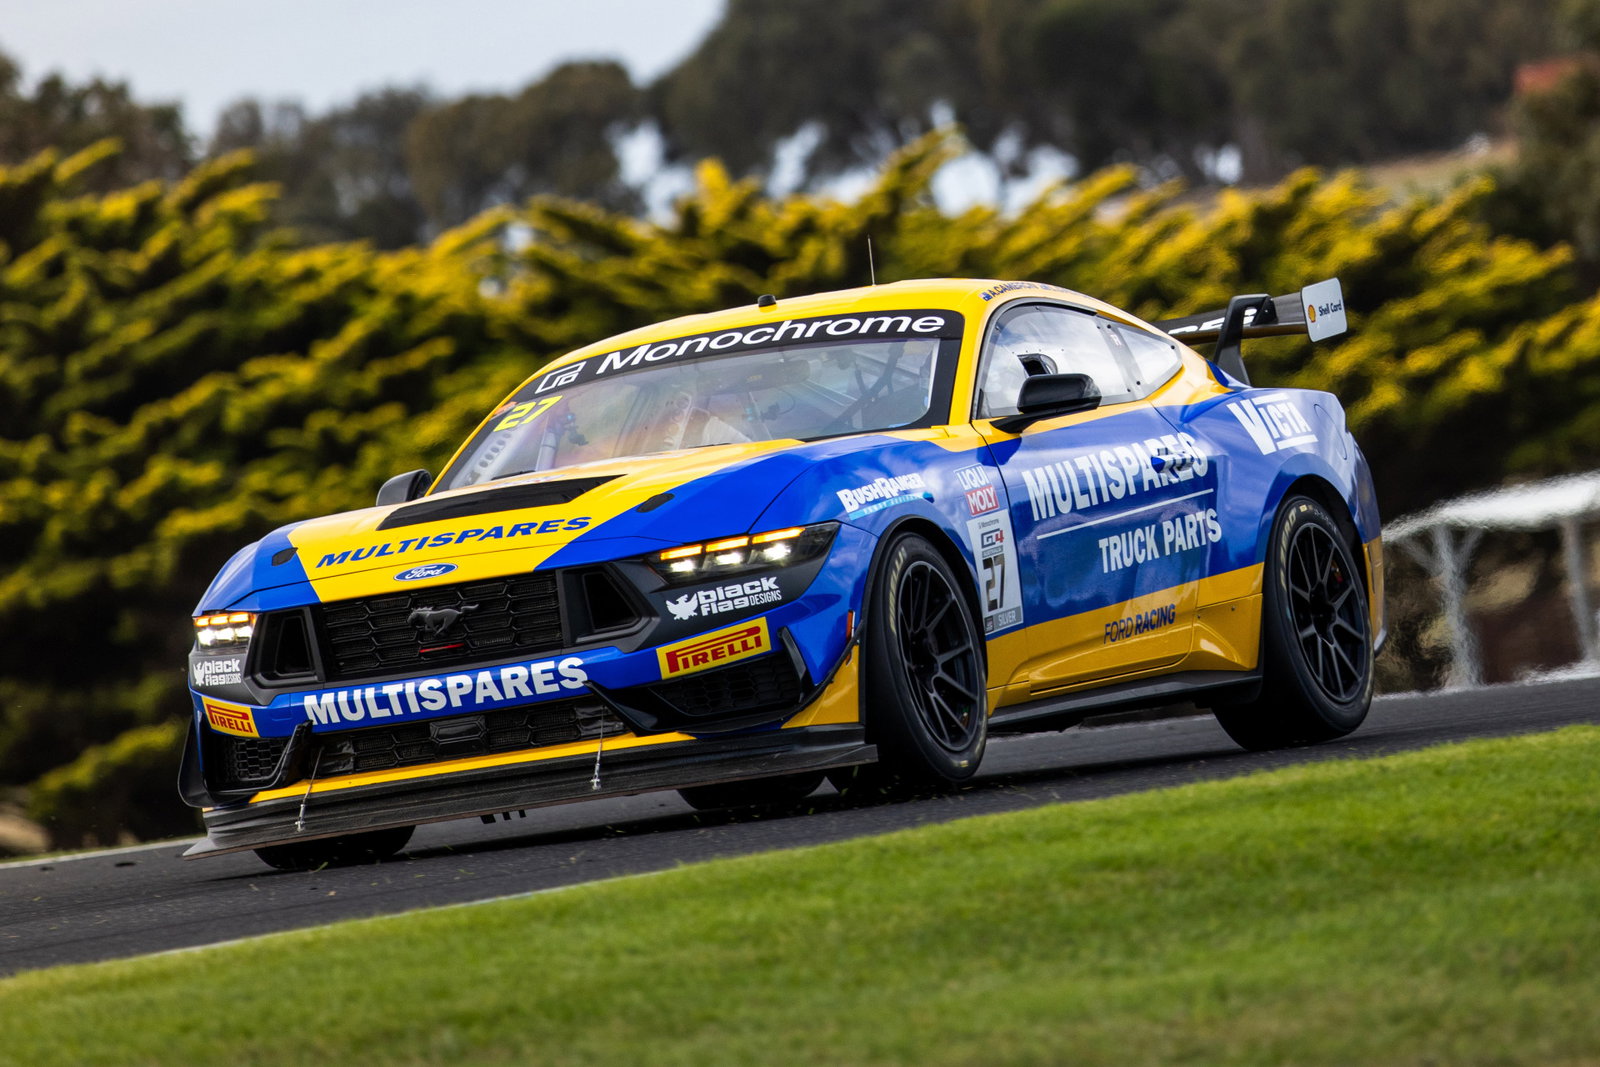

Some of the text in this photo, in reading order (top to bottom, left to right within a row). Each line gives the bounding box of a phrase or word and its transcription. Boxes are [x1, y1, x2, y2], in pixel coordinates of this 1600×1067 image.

[1318, 300, 1342, 316] Shell Card
[596, 315, 945, 375] Monochrome
[493, 395, 563, 433] 27
[1226, 398, 1313, 456] VICTA
[956, 465, 990, 491] LIQUI
[1021, 432, 1208, 522] MULTISPARES
[967, 488, 998, 514] MOLY
[316, 517, 592, 568] MULTISPARES
[1098, 508, 1222, 573] TRUCK PARTS
[404, 564, 446, 580] Ford
[697, 577, 779, 604] black
[982, 553, 1006, 612] 27
[700, 590, 782, 616] flag DESIGNS
[1103, 603, 1176, 645] FORD RACING
[204, 659, 240, 674] black
[666, 626, 762, 673] PIRELLI
[205, 673, 226, 686] flag
[303, 657, 588, 726] MULTISPARES
[205, 703, 253, 733] PIRELLI
